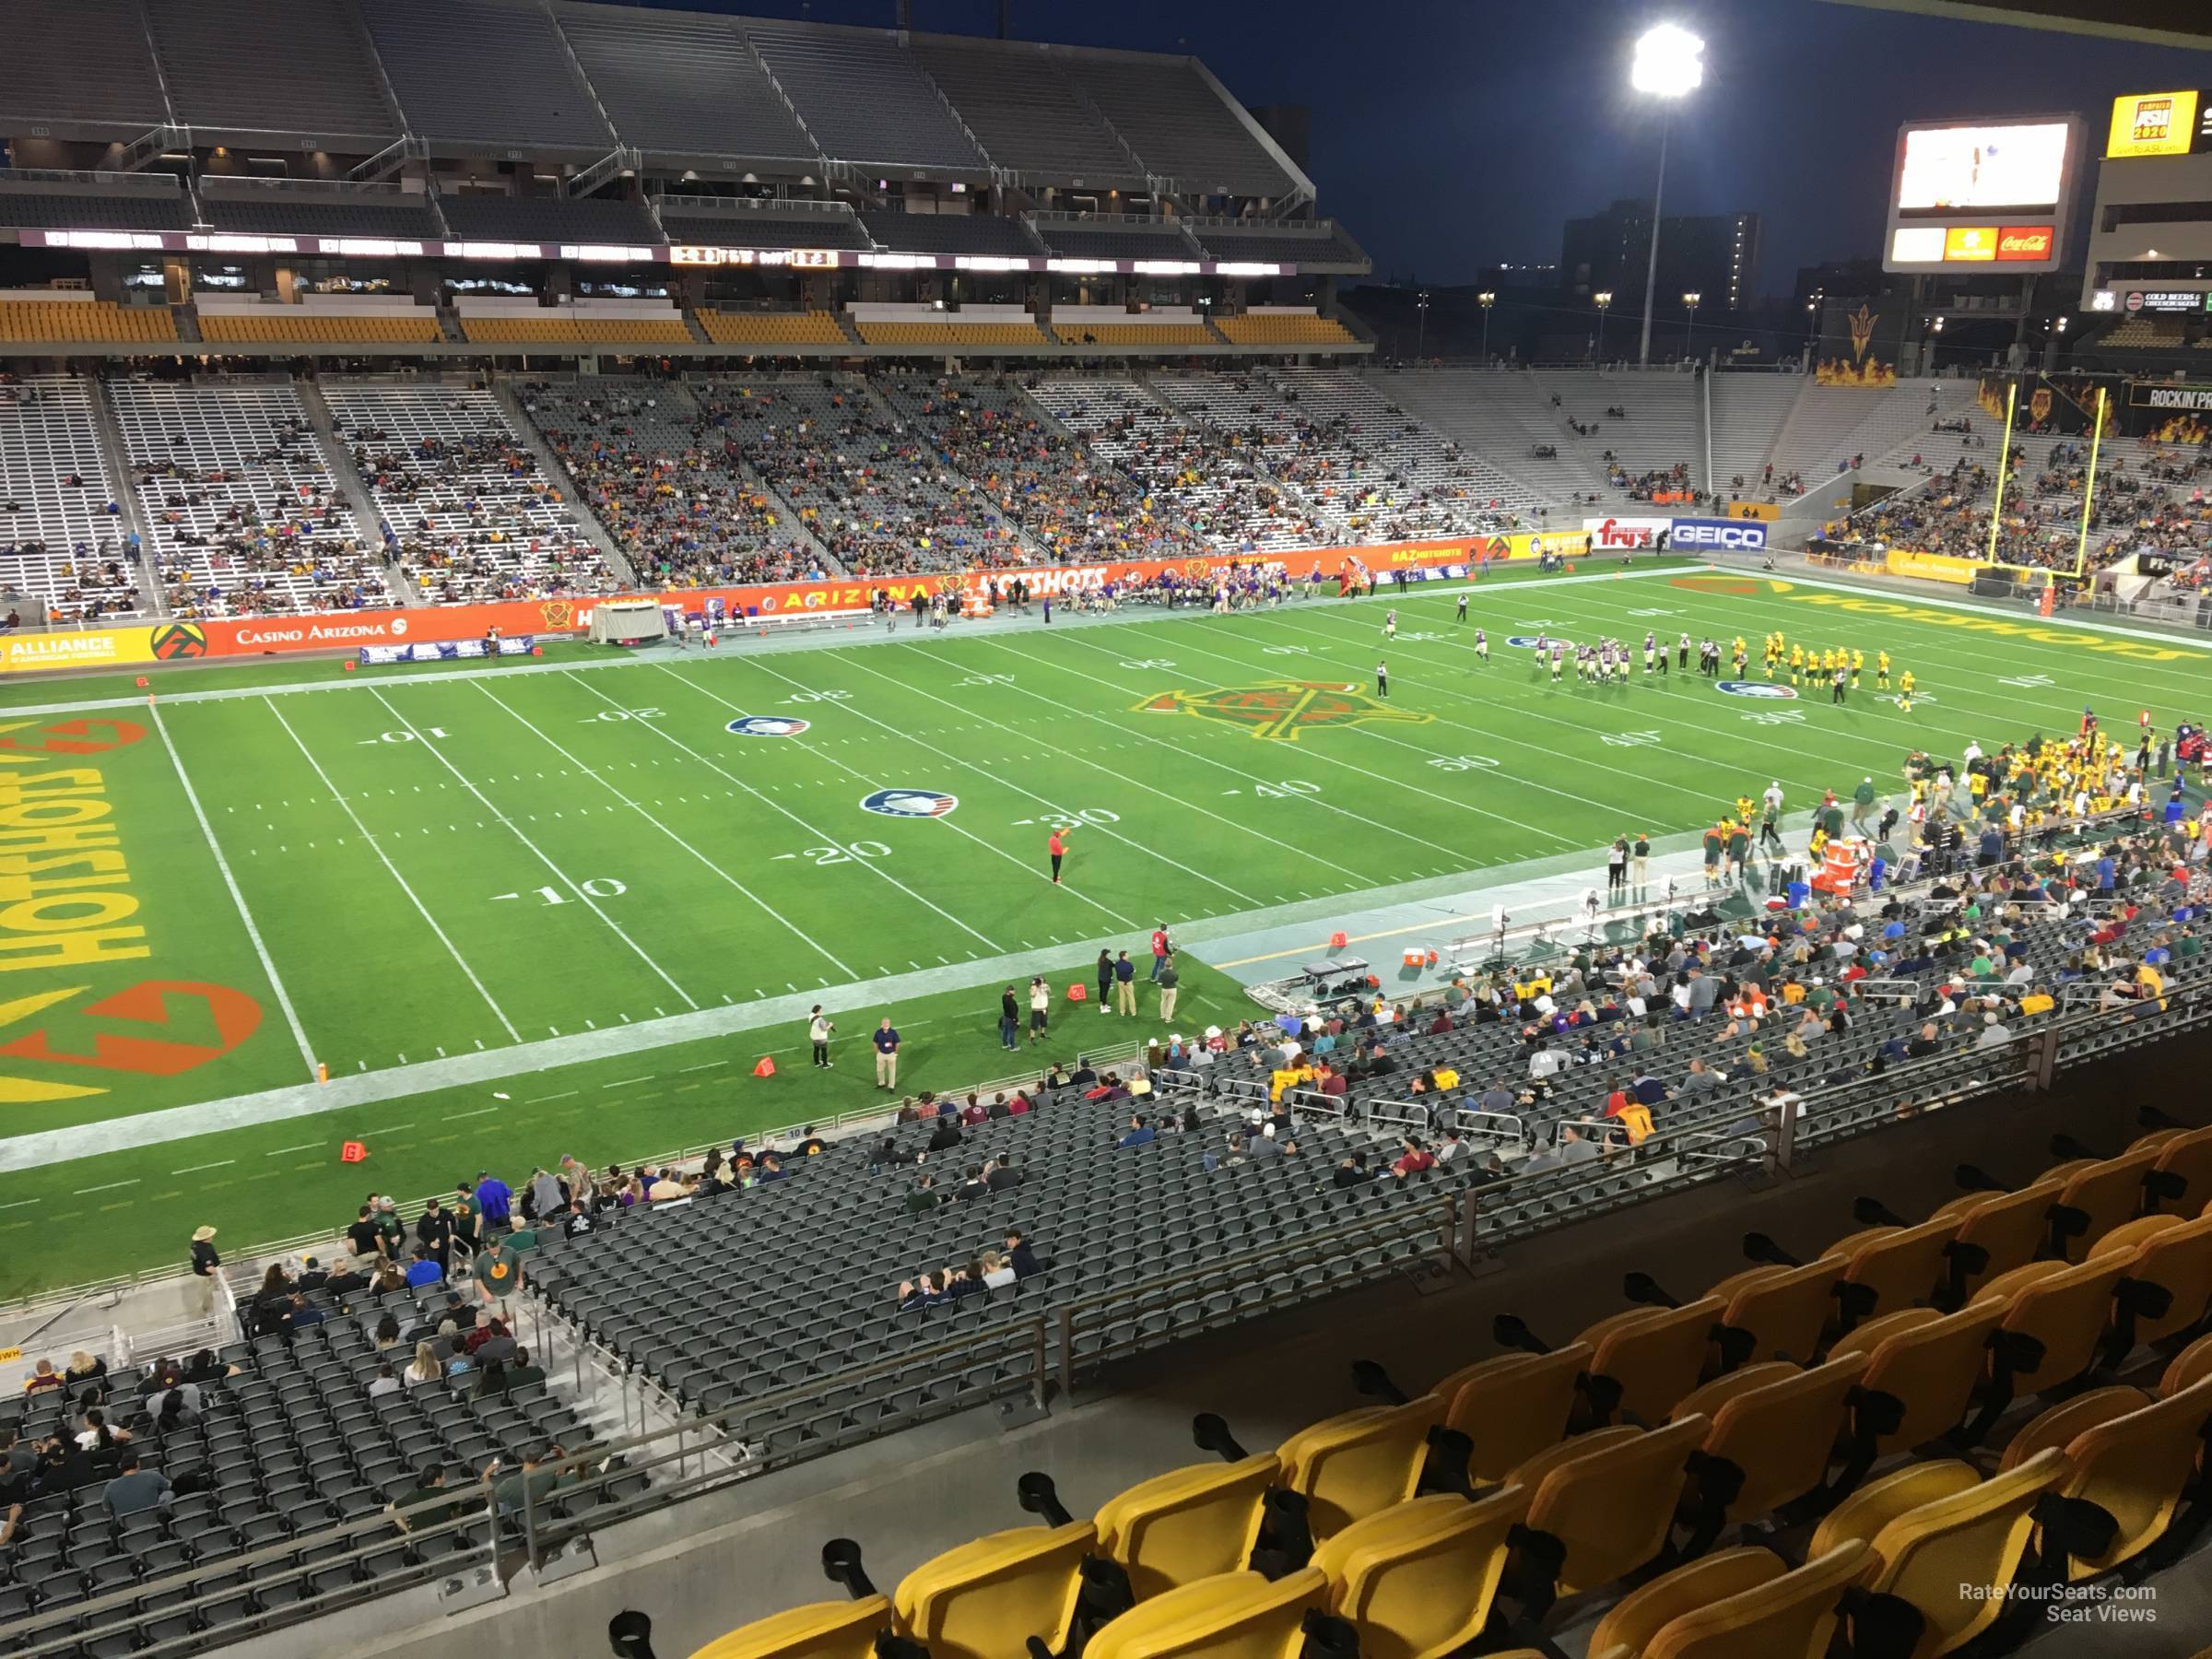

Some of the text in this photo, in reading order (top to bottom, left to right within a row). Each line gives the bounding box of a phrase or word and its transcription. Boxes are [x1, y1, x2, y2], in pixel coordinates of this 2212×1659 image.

[2134, 126, 2167, 138] 2020
[2149, 389, 2196, 406] ROCKIN'
[1597, 518, 1653, 547] fry's
[1674, 524, 1764, 547] GEICO
[236, 622, 385, 645] CASINO ARIZONA
[11, 636, 114, 655] ALLIANCE
[790, 689, 853, 703] 30
[598, 707, 667, 722] 20
[380, 726, 453, 743] 10
[1601, 730, 1663, 747] 40
[1426, 755, 1500, 772] 50
[1254, 781, 1321, 799] 40
[1040, 808, 1121, 830] 30
[803, 841, 893, 866] 20
[532, 877, 628, 907] 10
[789, 1129, 801, 1138] 10
[346, 1145, 357, 1159] G
